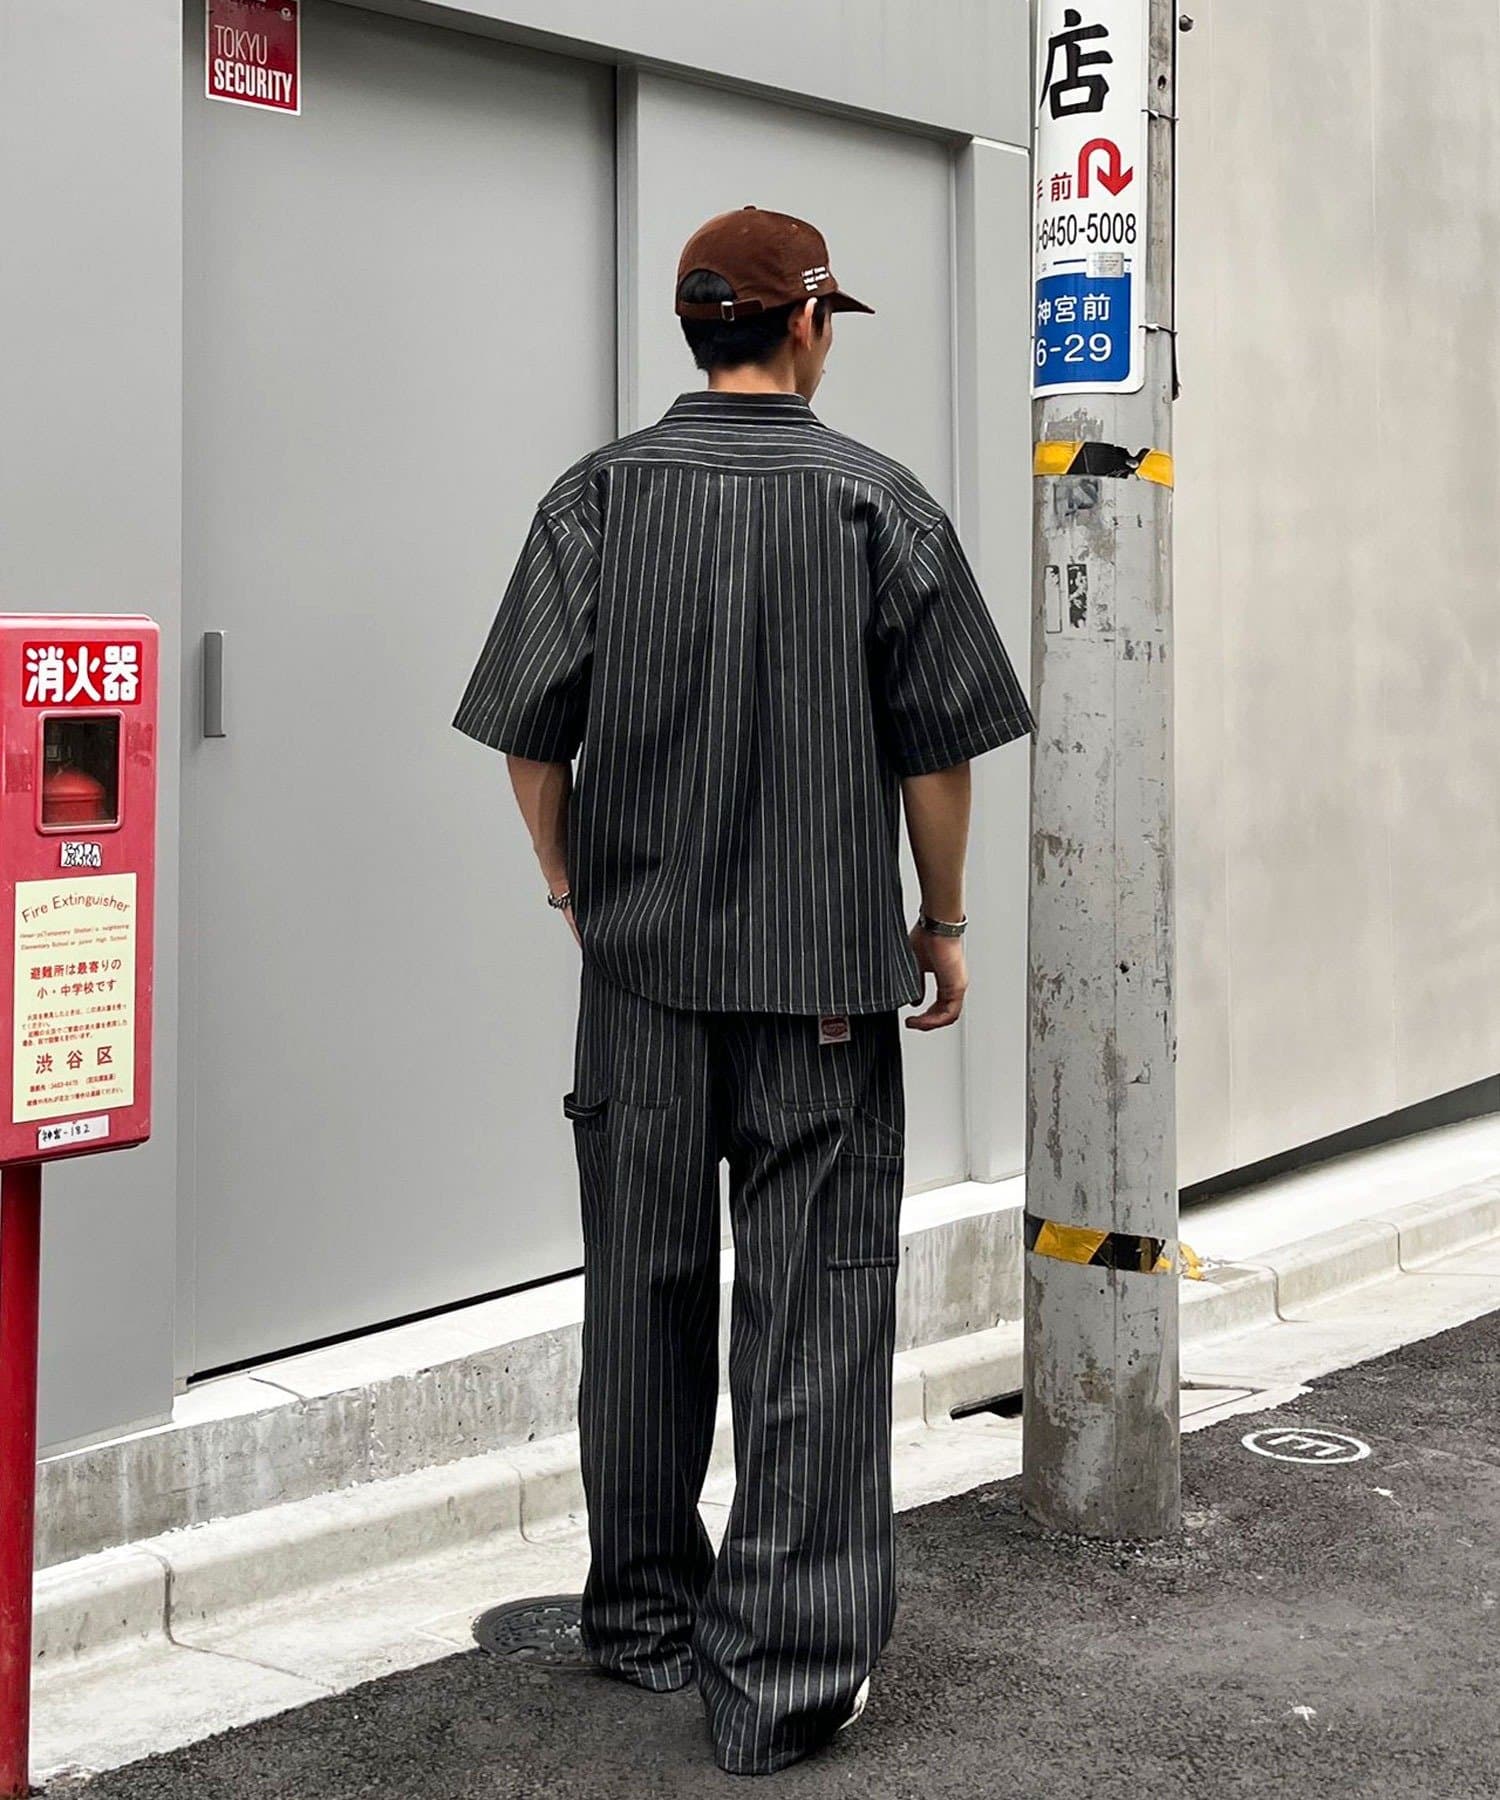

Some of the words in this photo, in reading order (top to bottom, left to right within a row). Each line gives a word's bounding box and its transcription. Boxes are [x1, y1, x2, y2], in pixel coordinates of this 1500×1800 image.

[214, 24, 267, 65] TOKYU
[214, 58, 292, 103] SECURITY
[1039, 9, 1113, 120] 店
[1037, 213, 1136, 250] -6450-5008
[1038, 293, 1111, 326] 神宮前
[1037, 333, 1112, 367] 6-29
[25, 645, 138, 703] 消火器
[22, 904, 48, 923] Fire
[52, 893, 130, 913] Extinguisher
[30, 959, 121, 980] 避難所は最寄りの
[37, 979, 117, 999] 小・中学校です
[35, 1045, 113, 1074] 渋谷区
